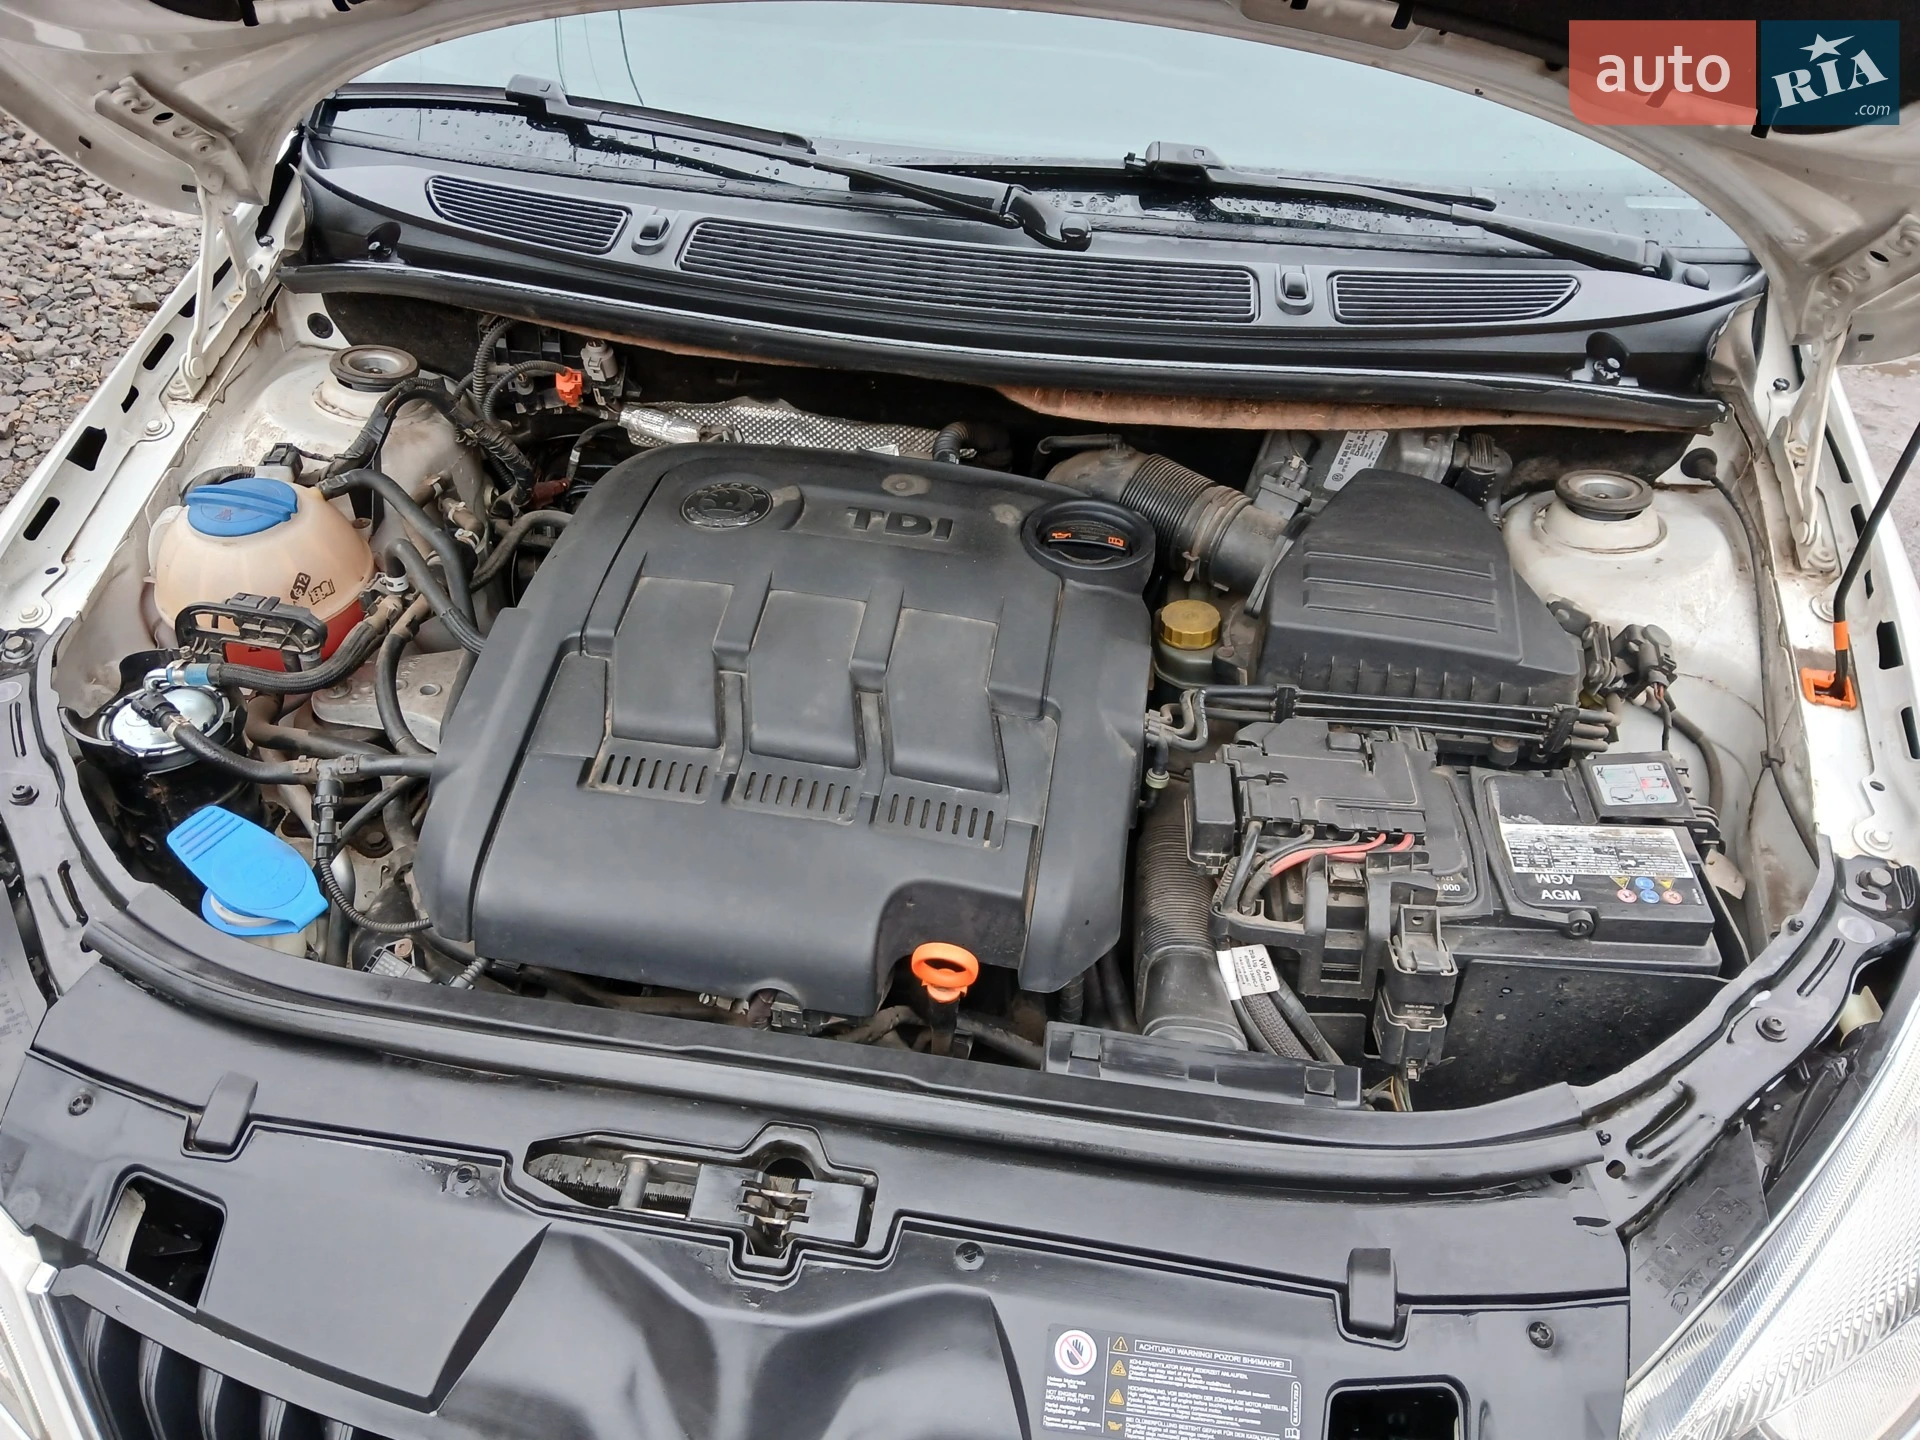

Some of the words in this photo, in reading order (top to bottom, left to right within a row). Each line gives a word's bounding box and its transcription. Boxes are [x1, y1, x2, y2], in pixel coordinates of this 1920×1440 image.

[846, 506, 954, 541] TDI
[1536, 873, 1574, 885] AGM
[1541, 889, 1582, 901] AGM
[1258, 957, 1267, 969] VW
[1263, 970, 1272, 981] AG
[1139, 1343, 1176, 1354] ACHTUNG!
[1177, 1348, 1213, 1359] WARNING!
[1213, 1352, 1241, 1363] POZOR!
